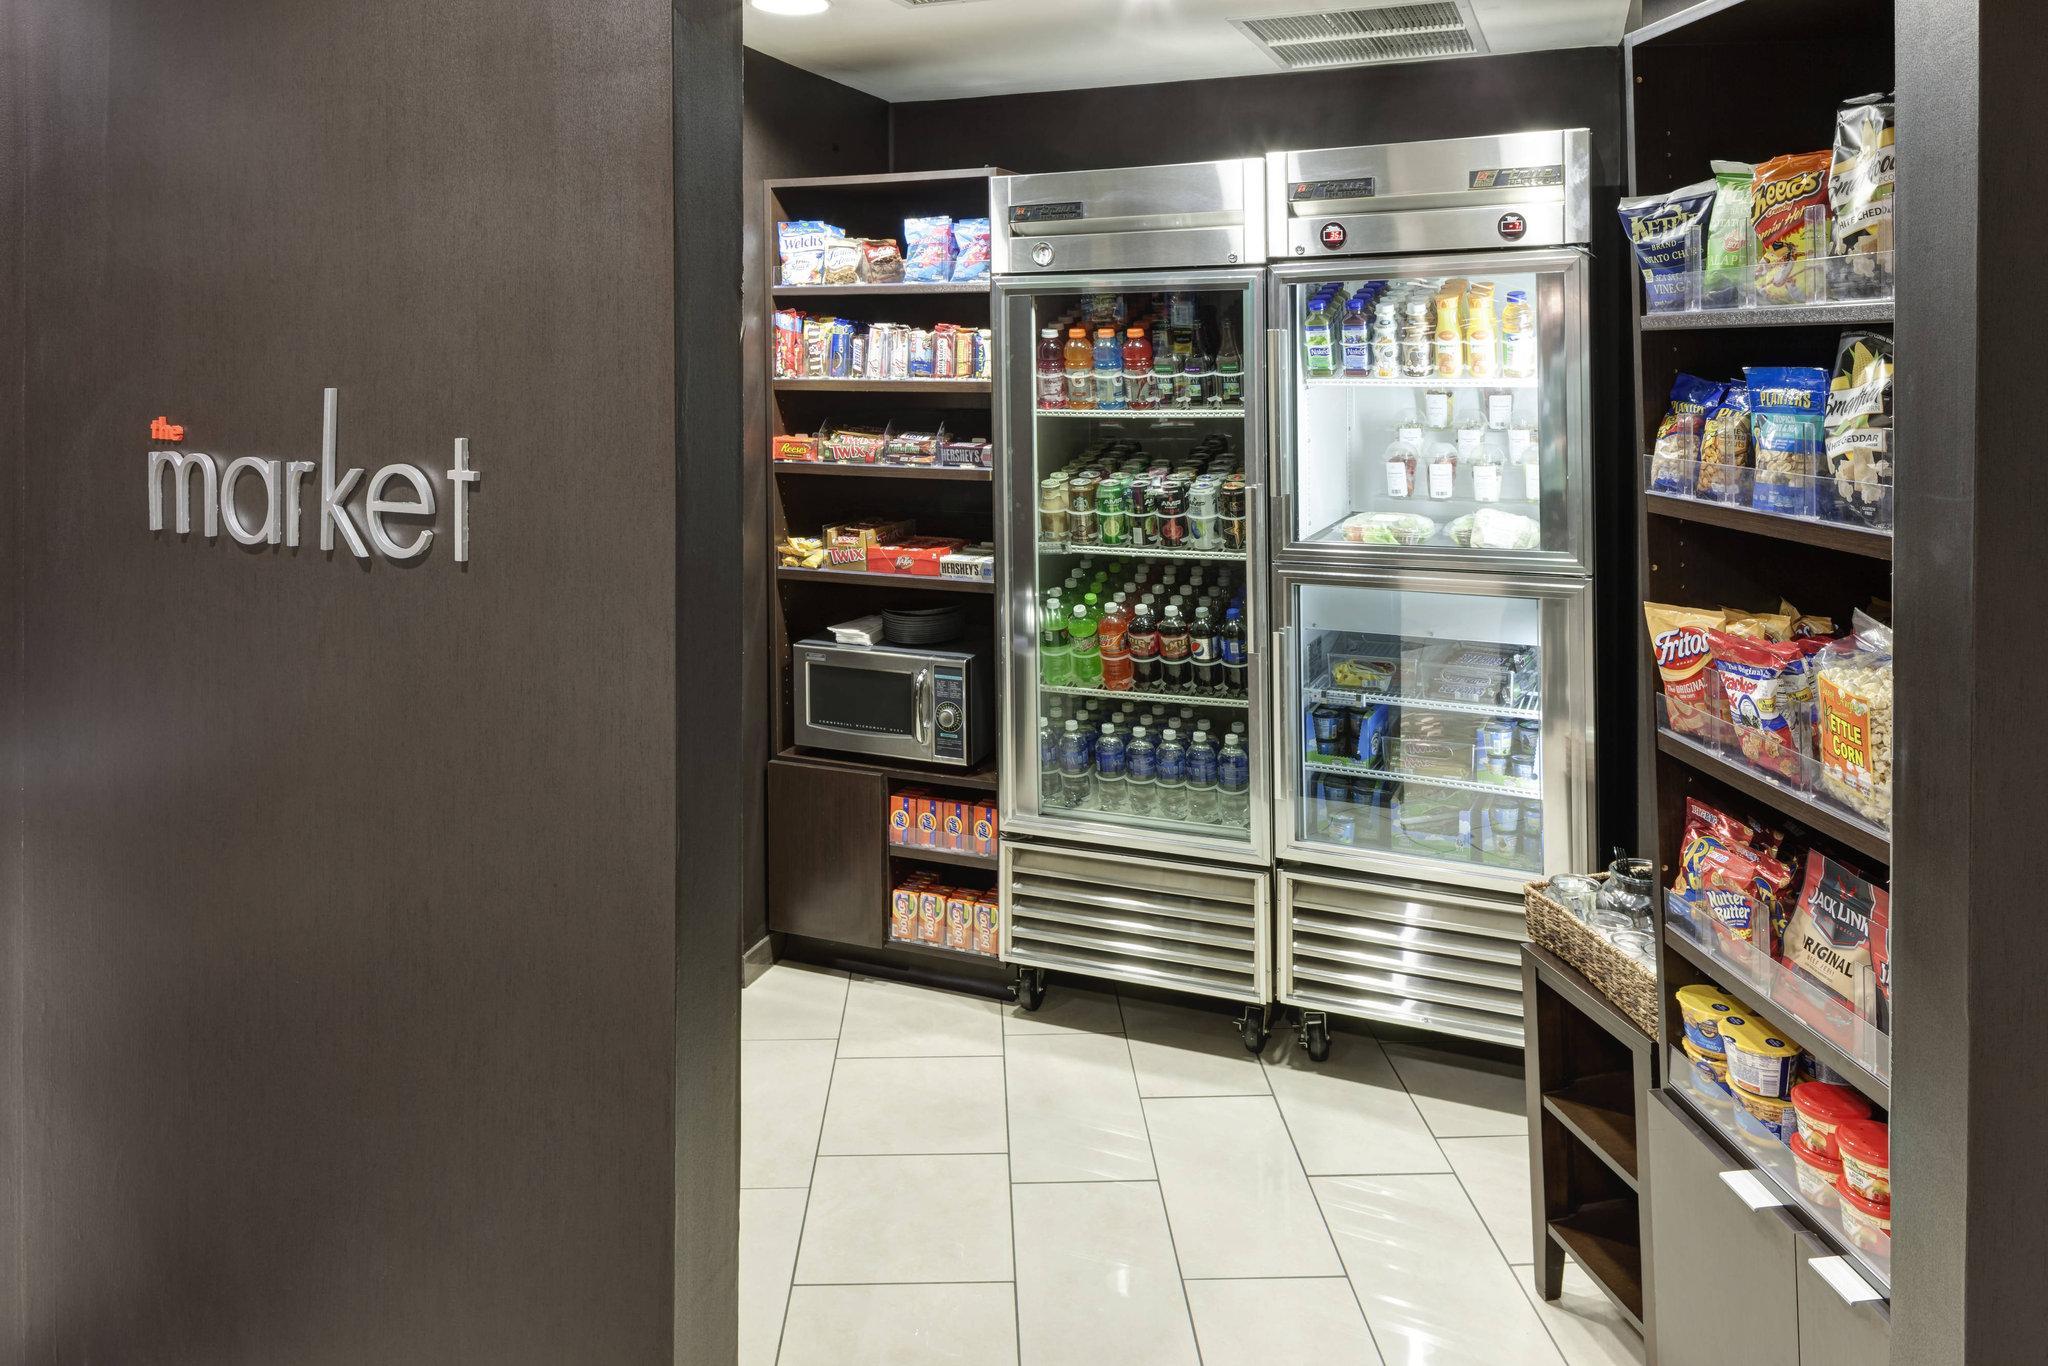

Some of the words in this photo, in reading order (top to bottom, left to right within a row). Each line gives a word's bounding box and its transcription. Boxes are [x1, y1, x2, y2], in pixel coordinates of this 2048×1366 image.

[1750, 171, 1819, 225] heetos
[1839, 215, 1857, 229] HITE
[1858, 206, 1892, 221] CHEDDA
[784, 235, 823, 250] Welch's
[1651, 240, 1677, 251] BRAND
[1654, 280, 1692, 295] VINEG
[1760, 390, 1811, 409] PLANTERS
[151, 416, 184, 441] the
[781, 442, 807, 454] Reese's
[1842, 434, 1879, 446] CEDDAR
[831, 444, 866, 460] TWIX
[941, 448, 980, 462] HERSHEY'S
[148, 387, 480, 562] market
[1161, 499, 1181, 507] AMP
[830, 547, 866, 564] TWIX
[941, 562, 979, 576] HERSHEY'S
[1655, 628, 1710, 666] Fritos
[1832, 734, 1865, 768] CORN
[895, 812, 906, 828] Tide
[922, 814, 934, 832] Tide
[948, 817, 959, 835] Tide
[978, 821, 989, 840] Tide
[1706, 890, 1746, 908] Nutter
[1714, 905, 1751, 922] Butter
[1808, 886, 1837, 919] JACK
[1837, 902, 1869, 937] LINK
